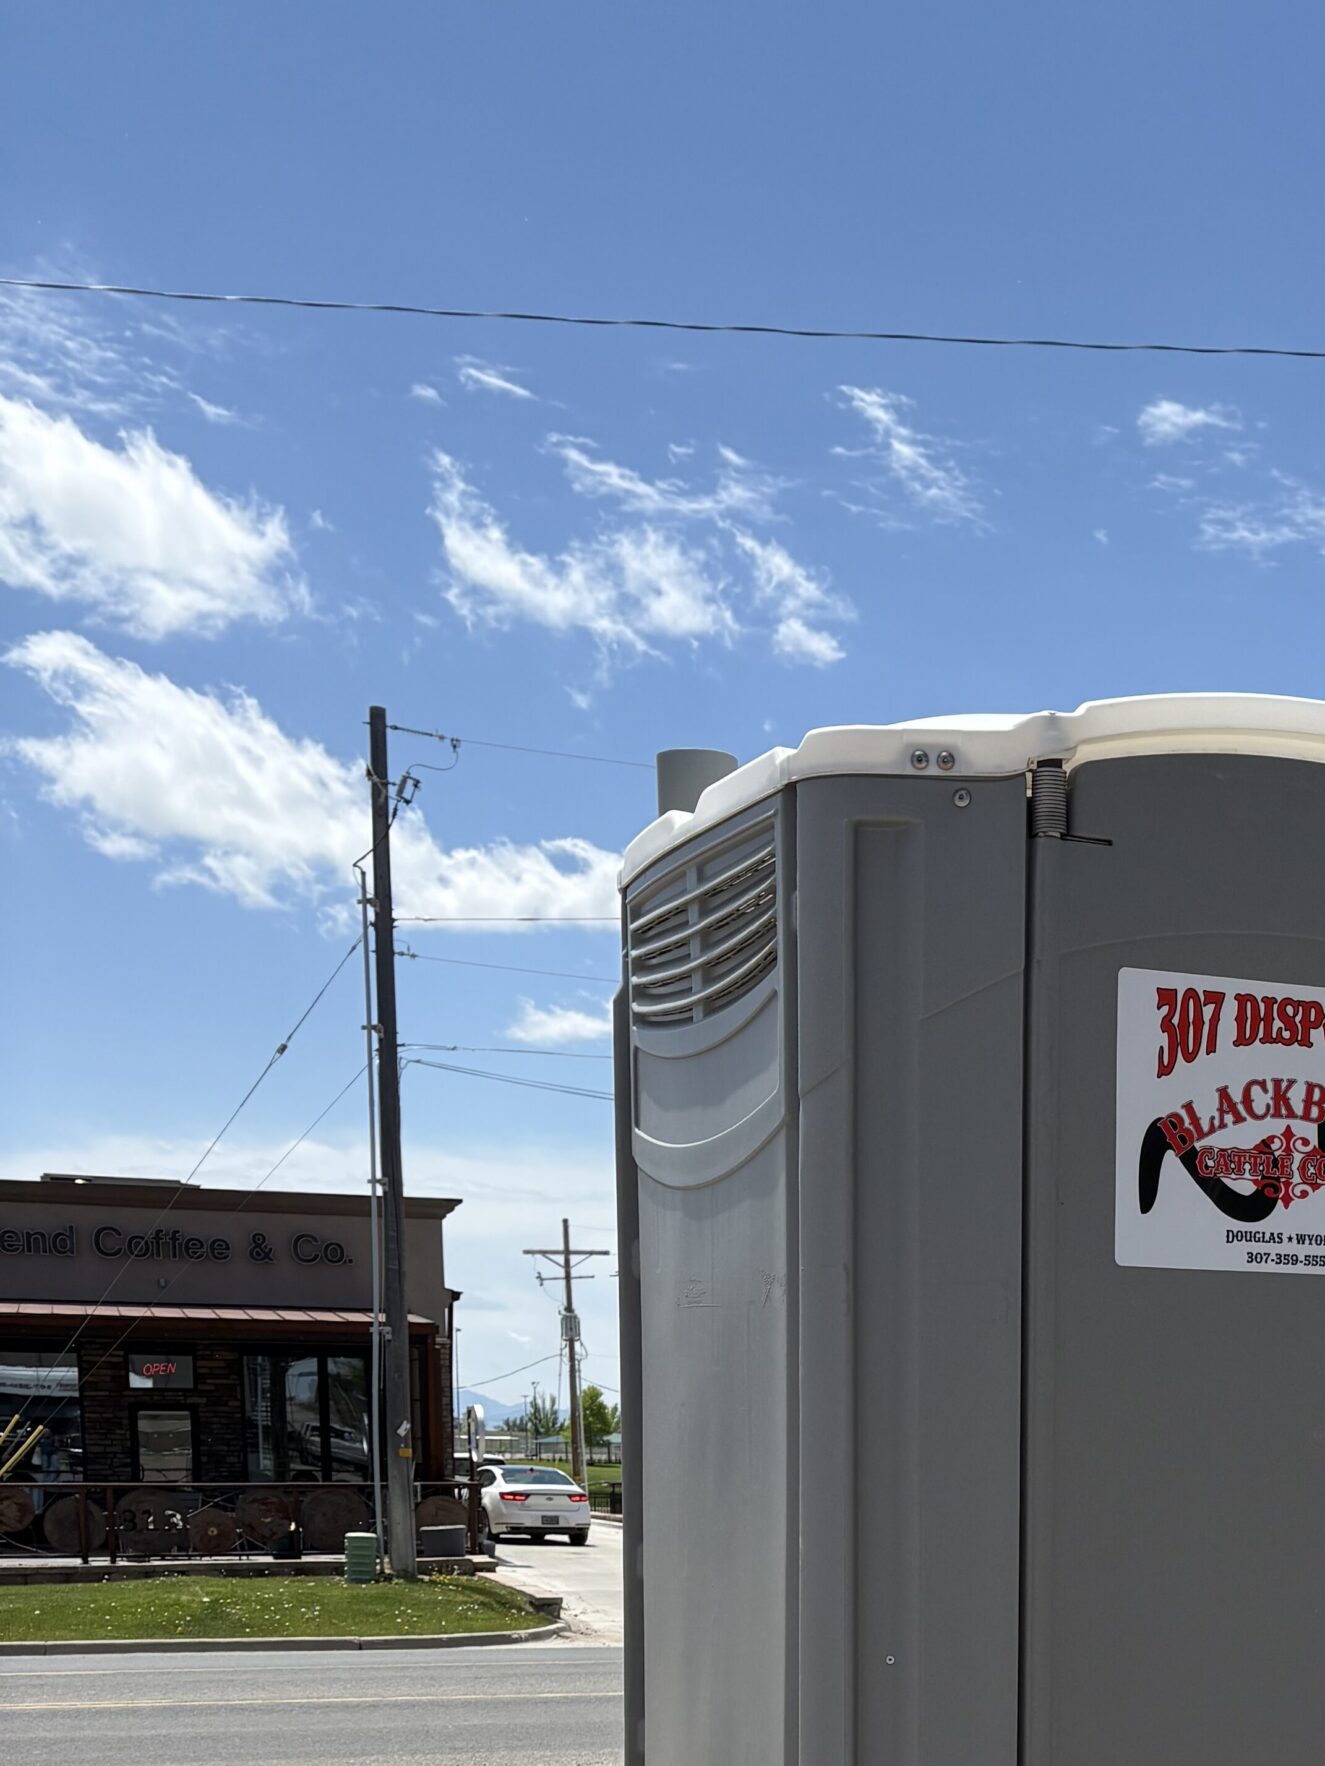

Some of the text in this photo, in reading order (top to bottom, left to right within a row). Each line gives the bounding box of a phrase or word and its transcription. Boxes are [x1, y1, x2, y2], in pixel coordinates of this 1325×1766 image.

[1157, 987, 1226, 1078] 307
[1195, 1148, 1294, 1179] CATTLE
[92, 1225, 231, 1262] Coffee
[249, 1232, 275, 1264] &
[291, 1233, 354, 1265] Co.
[1225, 1229, 1284, 1245] DOUGLAS
[142, 1361, 177, 1377] OPEN
